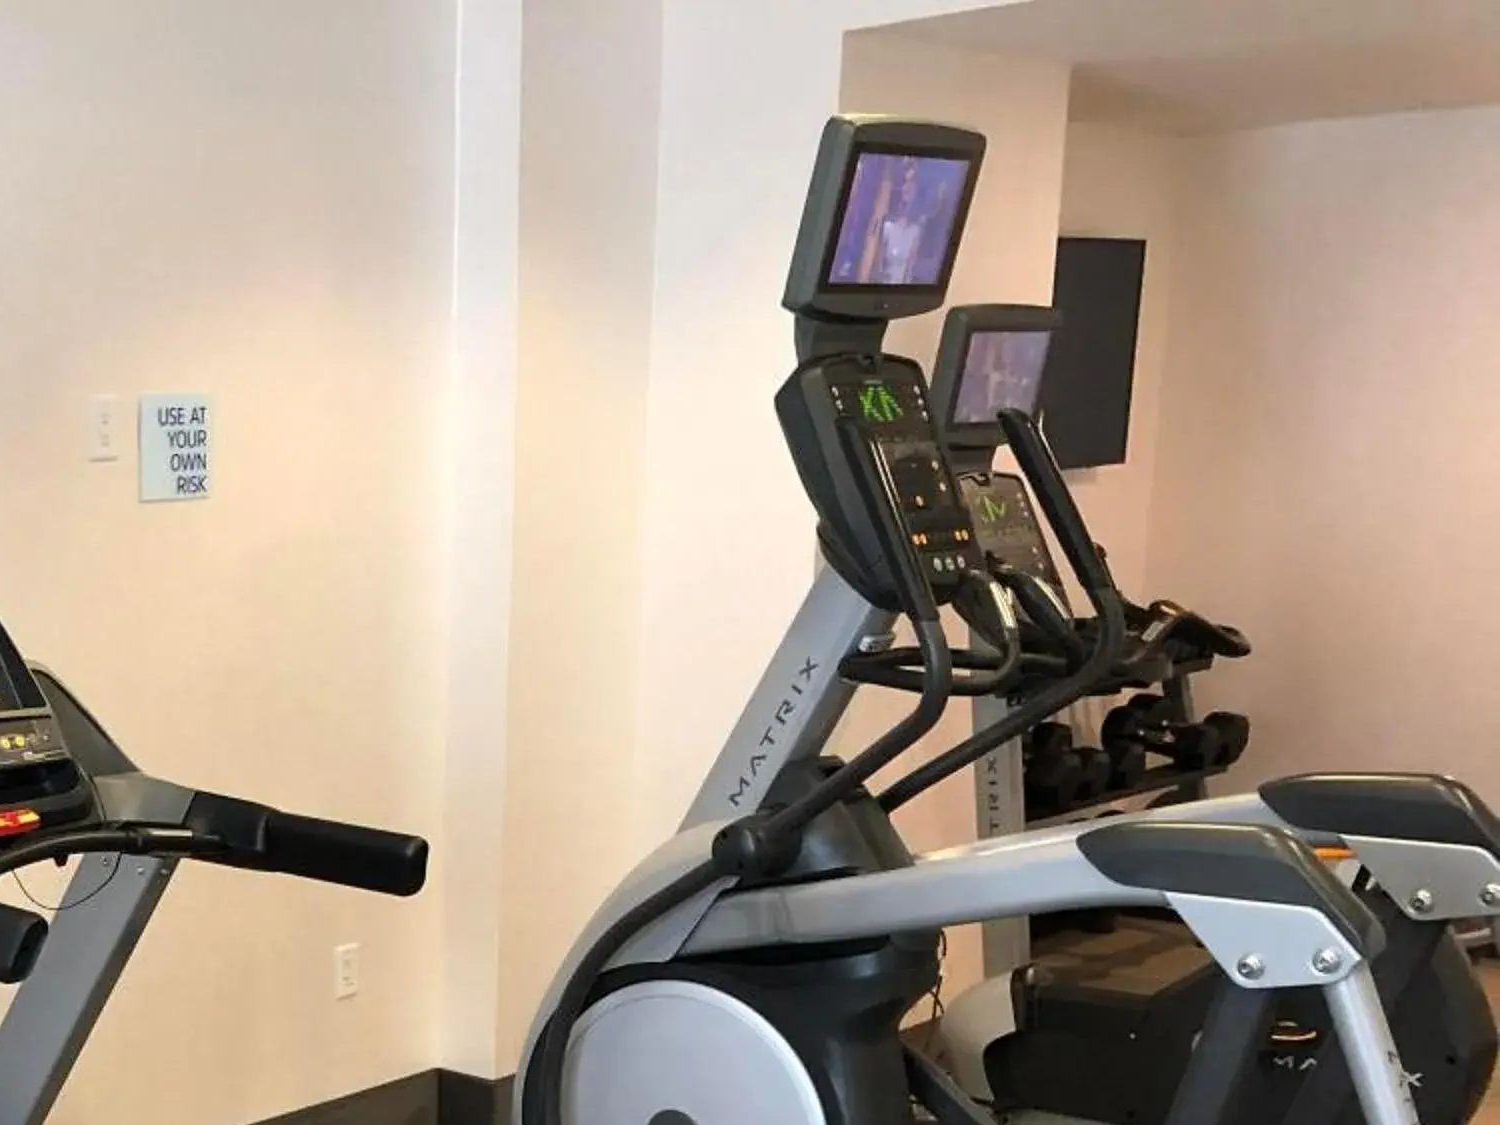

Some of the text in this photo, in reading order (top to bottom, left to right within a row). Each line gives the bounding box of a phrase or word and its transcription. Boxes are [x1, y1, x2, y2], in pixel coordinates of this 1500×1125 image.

[158, 406, 207, 426] USE AT
[167, 430, 207, 448] YOUR
[170, 453, 207, 471] OWN
[177, 475, 207, 494] RISK
[729, 656, 819, 807] MATRIX
